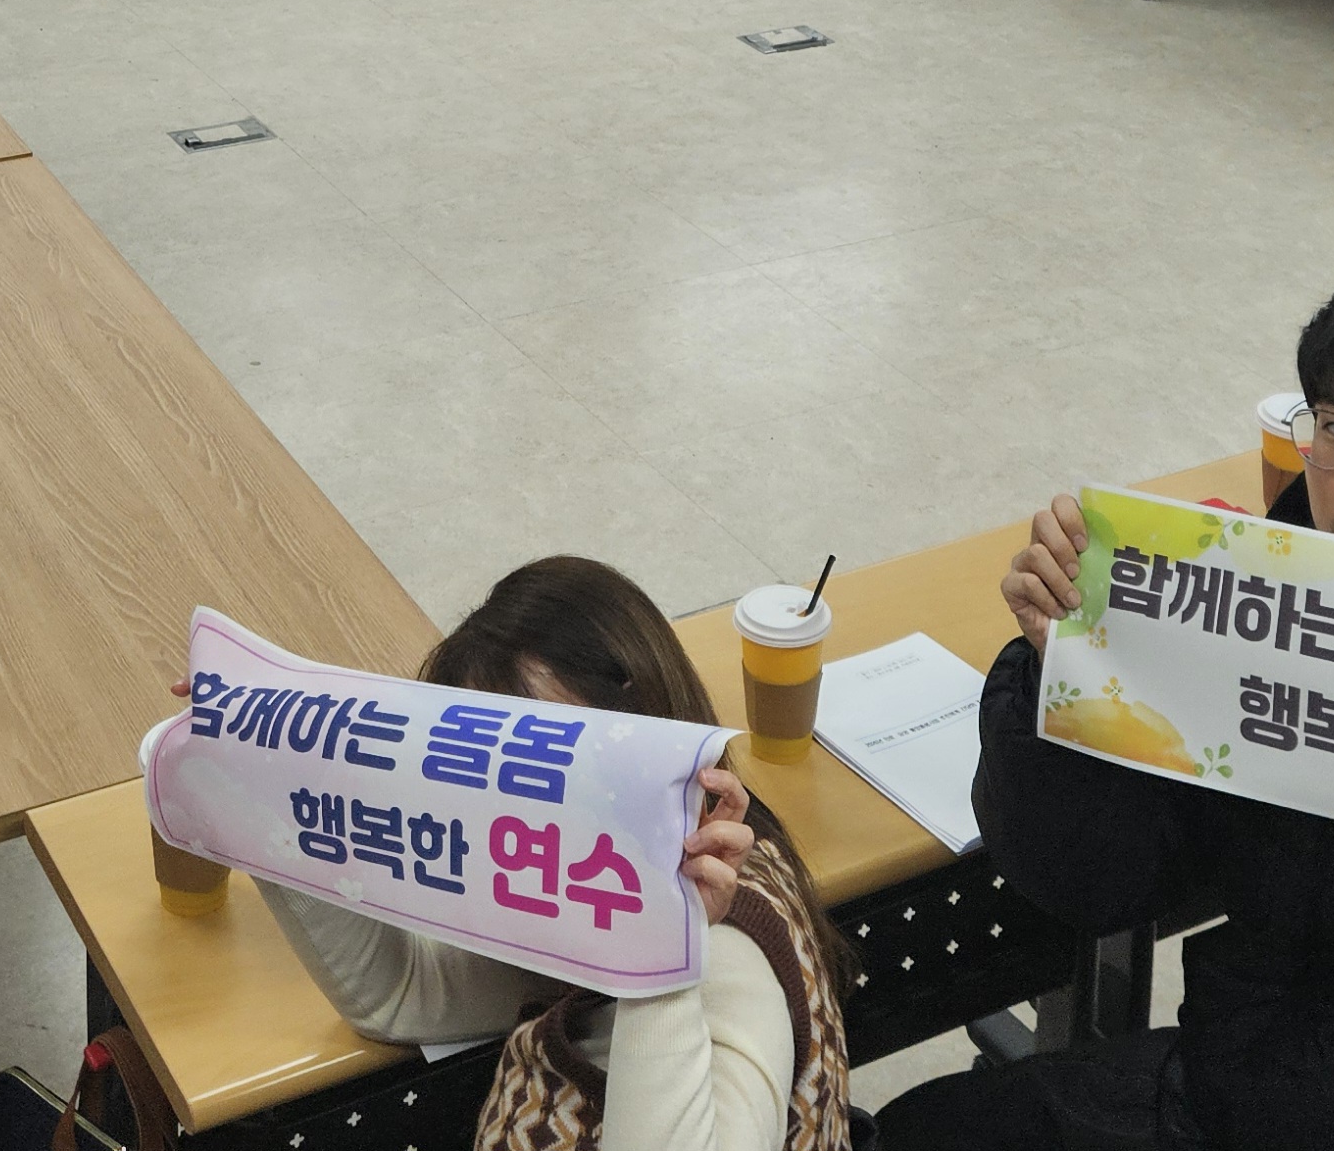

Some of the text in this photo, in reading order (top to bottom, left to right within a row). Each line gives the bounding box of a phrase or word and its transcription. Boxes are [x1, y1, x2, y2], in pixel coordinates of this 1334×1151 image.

[191, 670, 587, 804] 함께하는 돌봄
[290, 787, 644, 931] 행복한 연수
